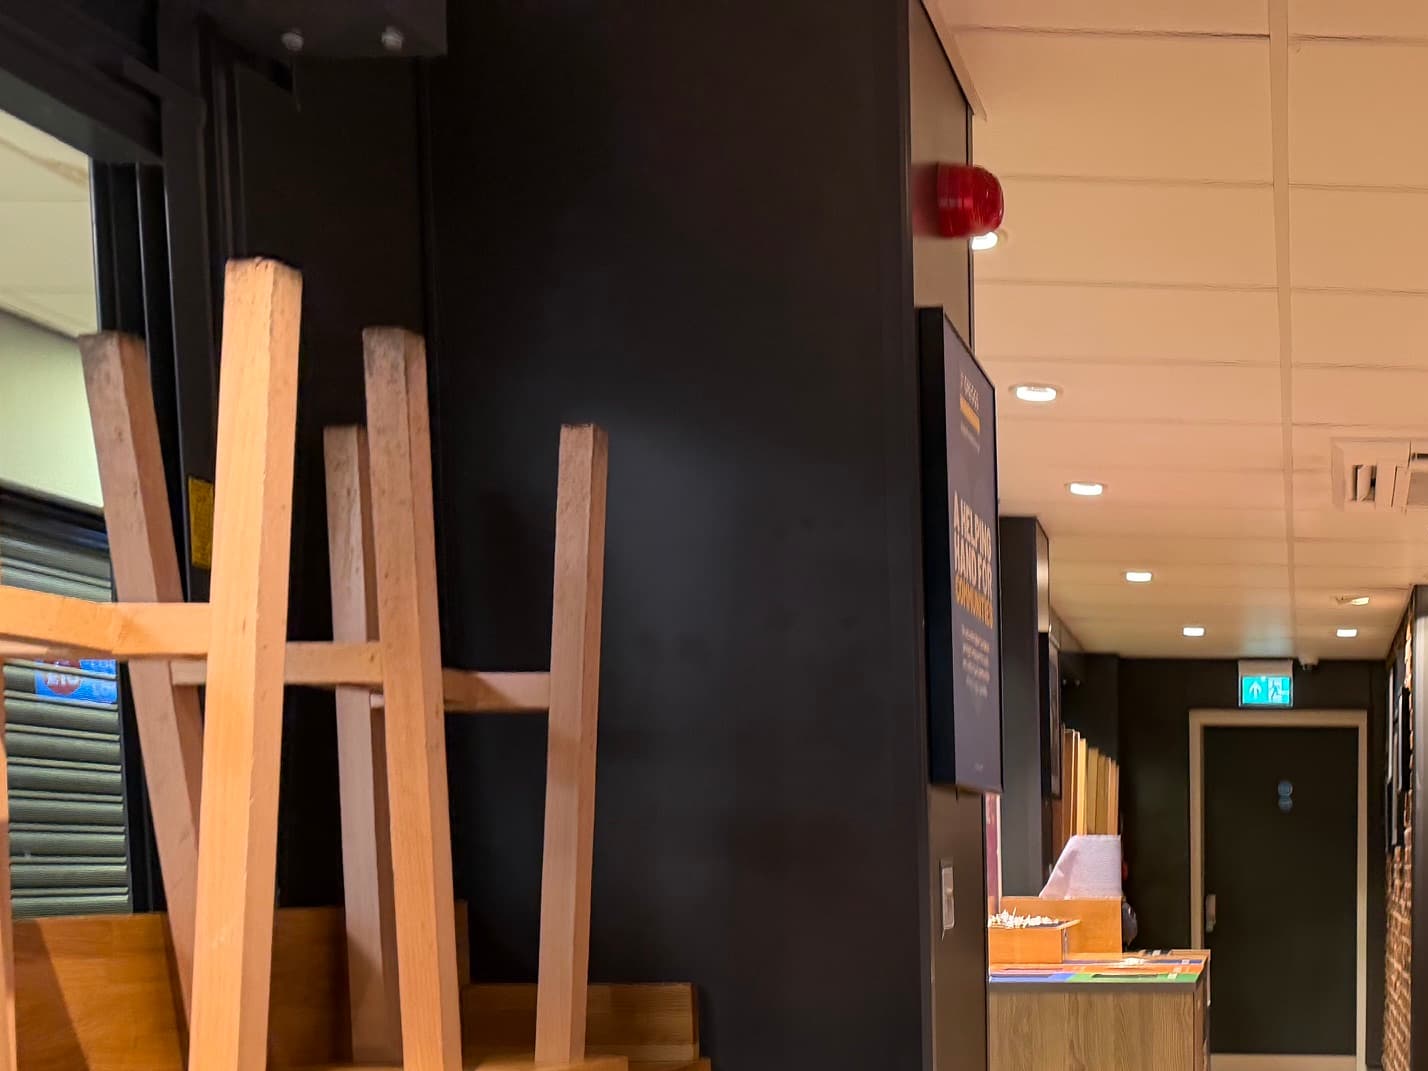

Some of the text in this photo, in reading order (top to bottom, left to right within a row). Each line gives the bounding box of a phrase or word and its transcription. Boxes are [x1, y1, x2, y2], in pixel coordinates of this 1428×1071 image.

[953, 490, 992, 564] A HELPING
[953, 530, 993, 604] HAND FOR
